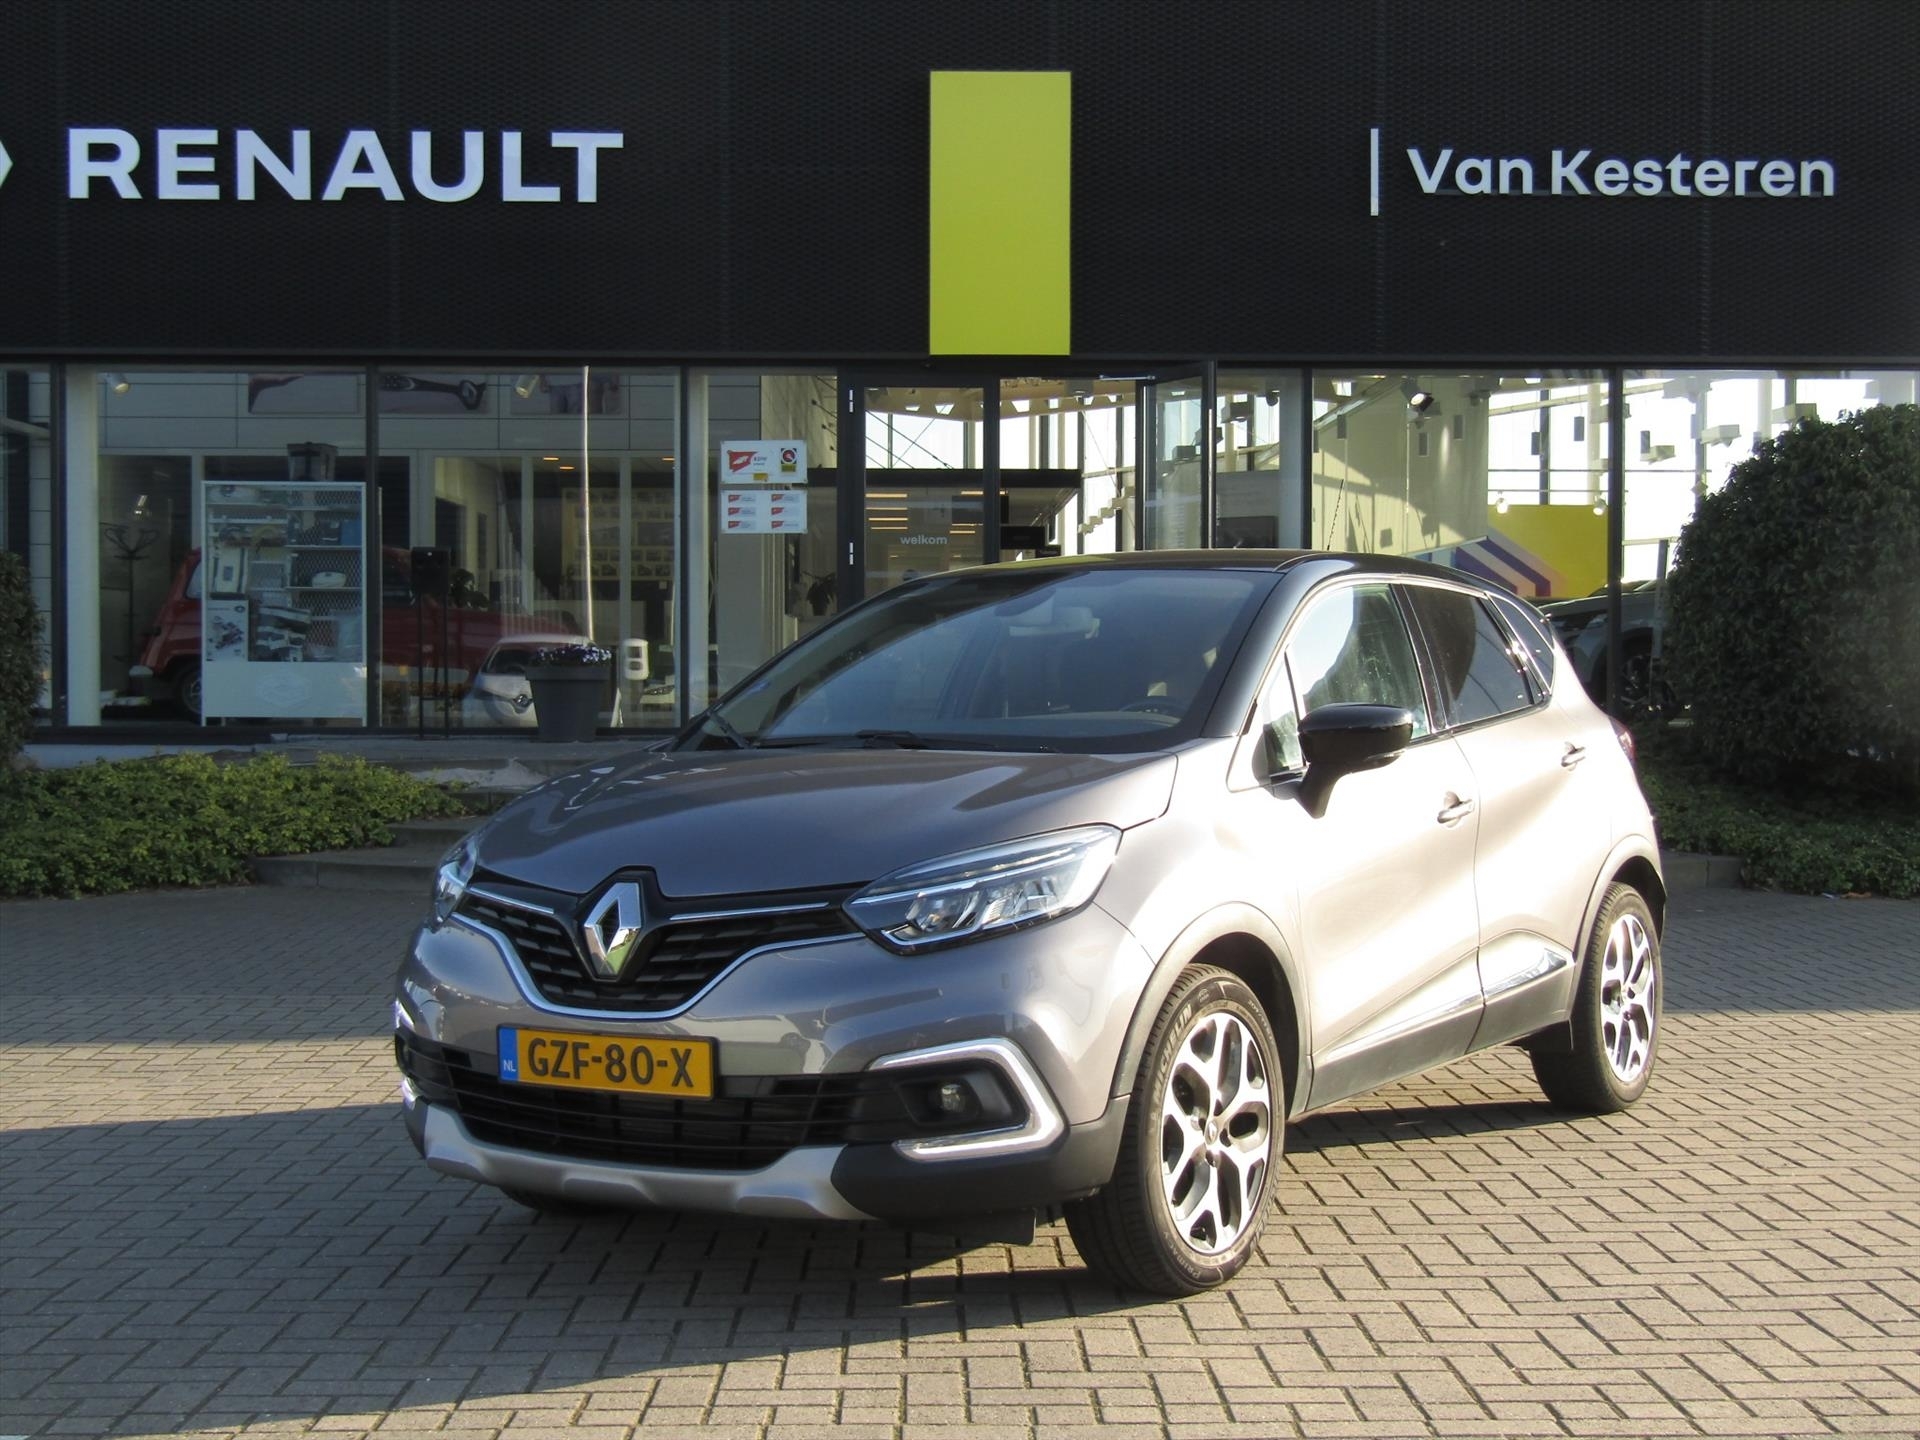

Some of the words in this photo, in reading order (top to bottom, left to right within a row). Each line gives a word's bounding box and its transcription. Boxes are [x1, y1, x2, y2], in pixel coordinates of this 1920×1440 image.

[68, 128, 624, 203] RENAULT
[1406, 148, 1533, 195] Van
[1551, 150, 1834, 197] Kesteren
[900, 534, 948, 545] welkom
[503, 1059, 517, 1073] NL
[528, 1037, 694, 1088] GZF-80-X
[1152, 1003, 1193, 1106] MICHELIN
